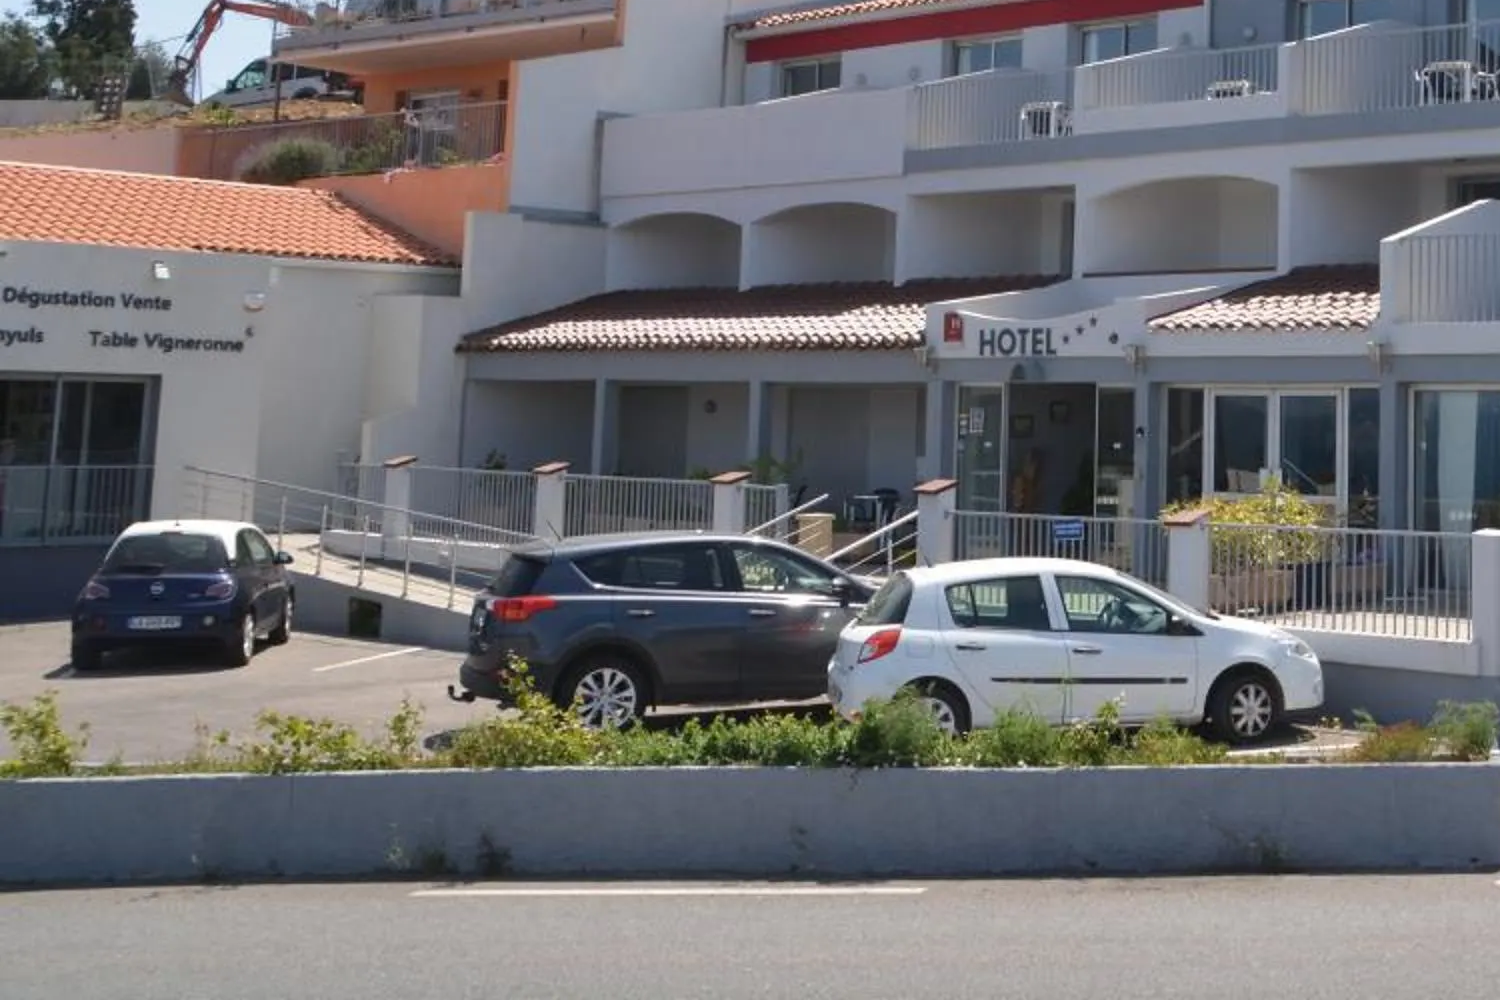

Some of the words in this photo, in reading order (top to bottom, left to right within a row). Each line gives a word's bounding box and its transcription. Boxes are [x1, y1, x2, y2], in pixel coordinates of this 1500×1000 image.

[3, 287, 115, 308] Dégustation
[121, 293, 172, 311] Vente
[88, 330, 138, 348] Table
[144, 333, 244, 353] Vigneronne
[979, 327, 1057, 356] HOTEL
